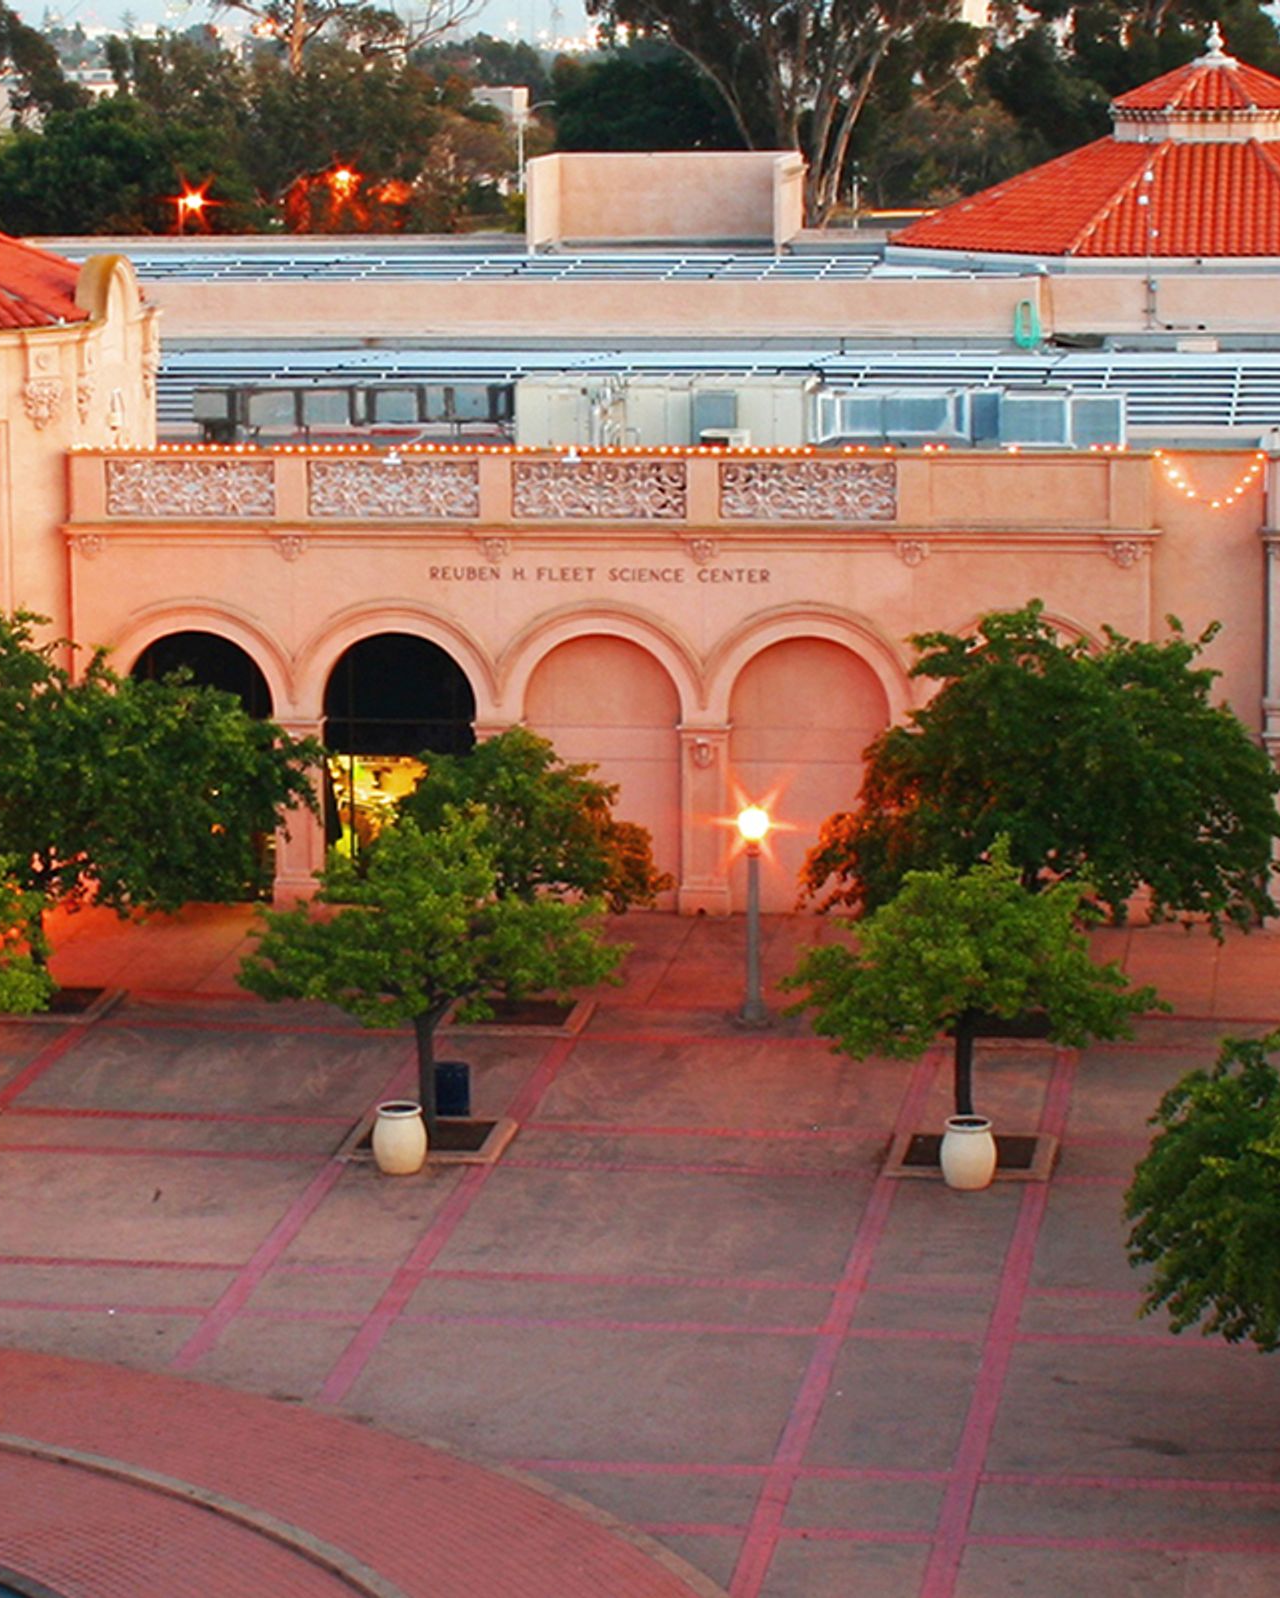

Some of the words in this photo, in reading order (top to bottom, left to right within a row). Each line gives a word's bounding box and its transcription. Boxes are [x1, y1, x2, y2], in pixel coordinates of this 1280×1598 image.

[429, 566, 500, 581] REUBEN
[537, 566, 596, 582] FLEET
[608, 567, 685, 583] SCIENCE
[697, 568, 771, 584] CENTER
